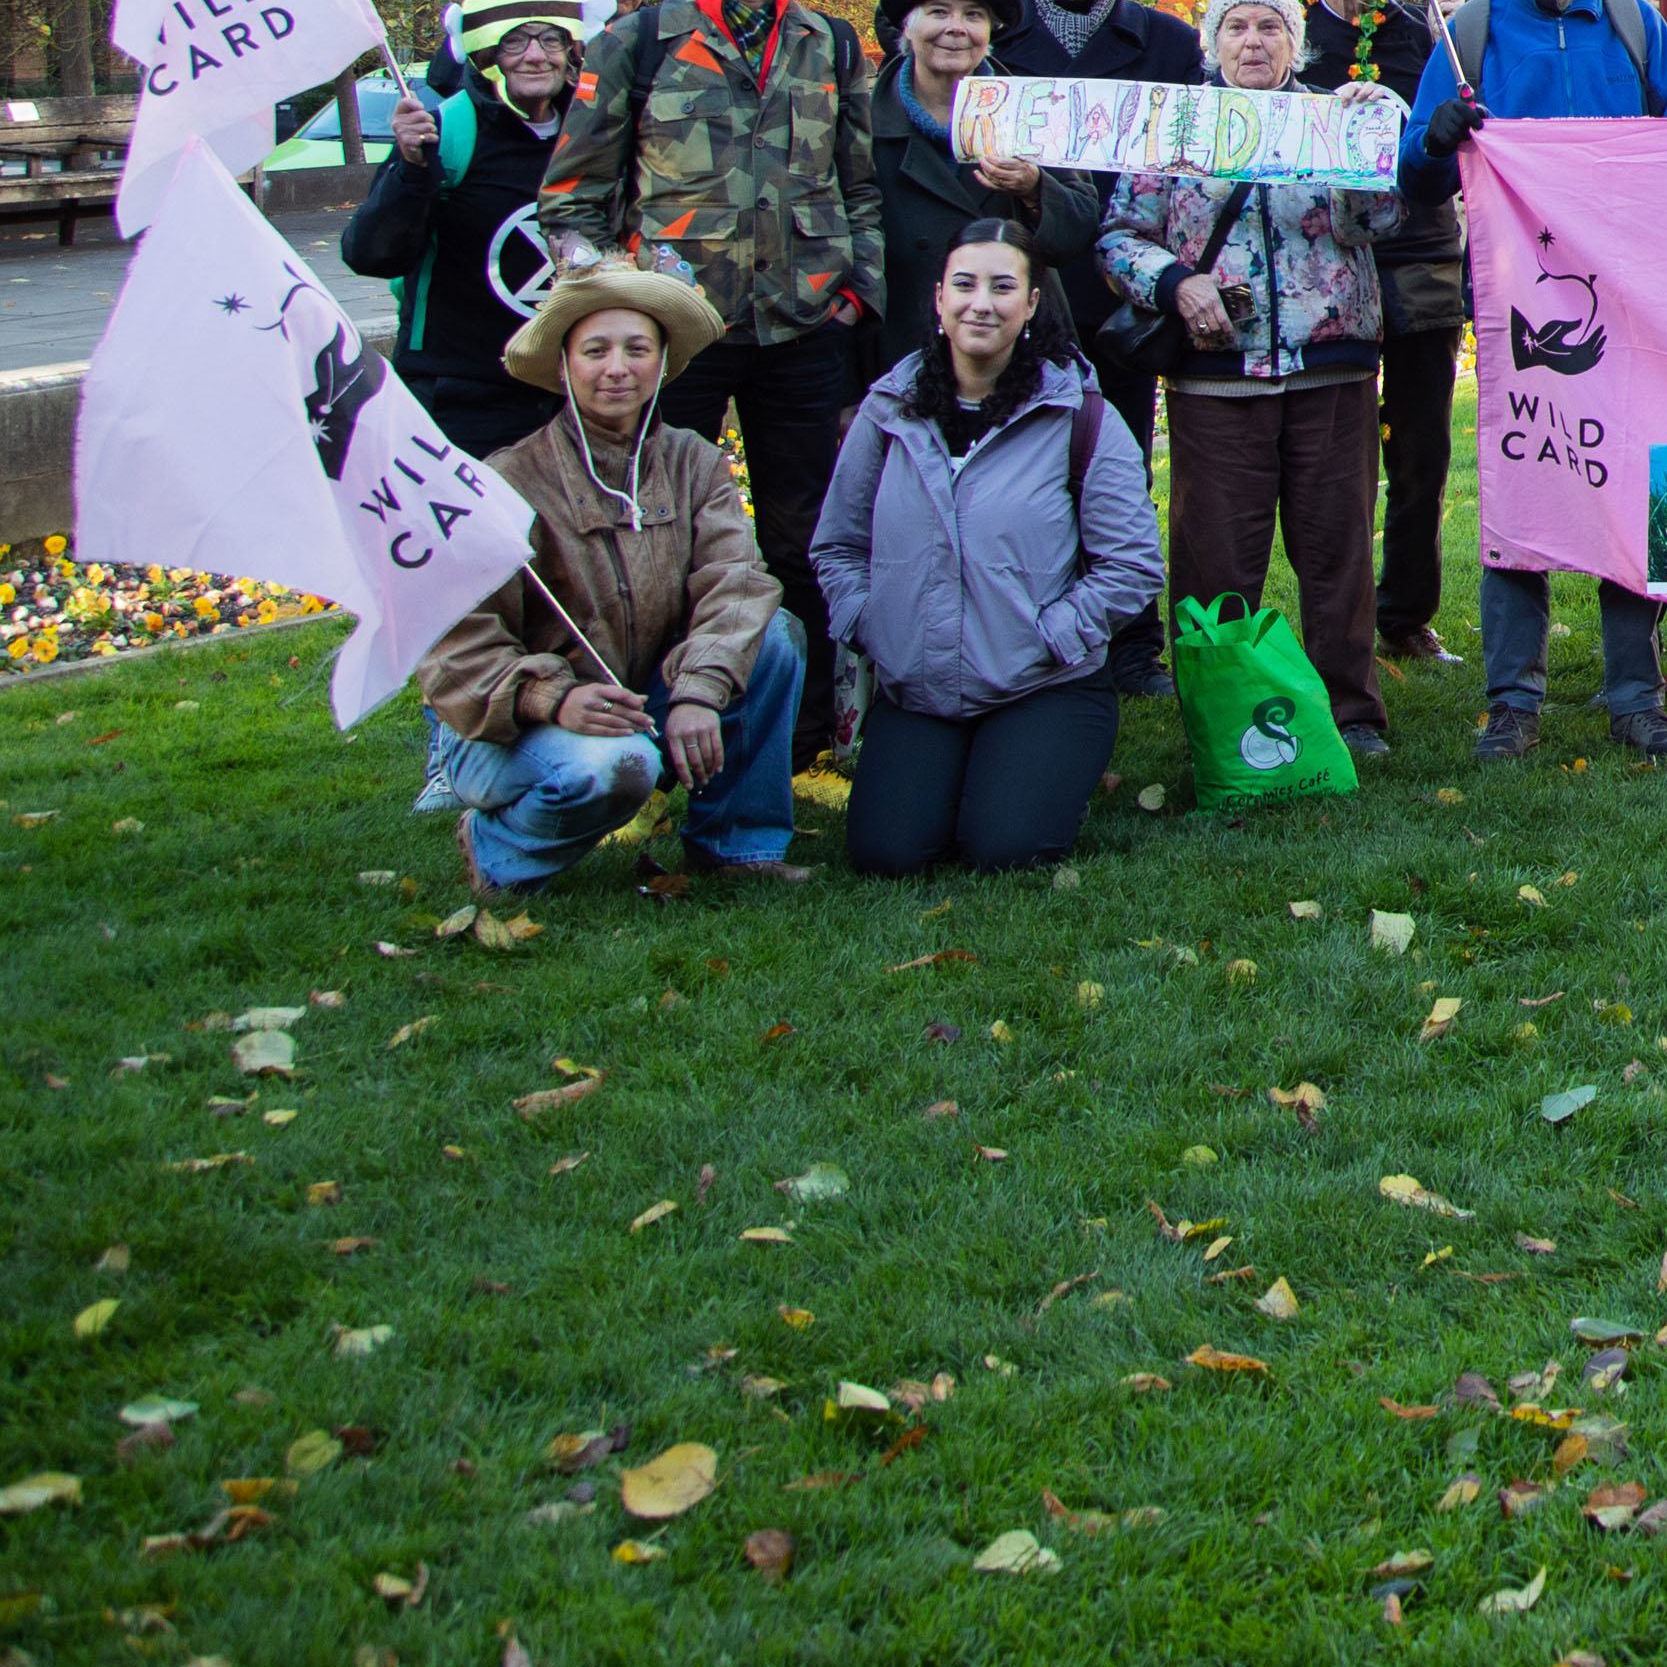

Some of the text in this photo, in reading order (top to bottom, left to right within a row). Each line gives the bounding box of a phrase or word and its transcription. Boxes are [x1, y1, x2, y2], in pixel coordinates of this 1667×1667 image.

[148, 5, 295, 97] CARD
[958, 78, 1396, 176] REWILDING
[1501, 430, 1608, 488] CARD
[1508, 391, 1605, 448] WILD
[360, 435, 451, 524] WIL
[390, 462, 487, 569] CAR
[1298, 767, 1332, 792] Café
